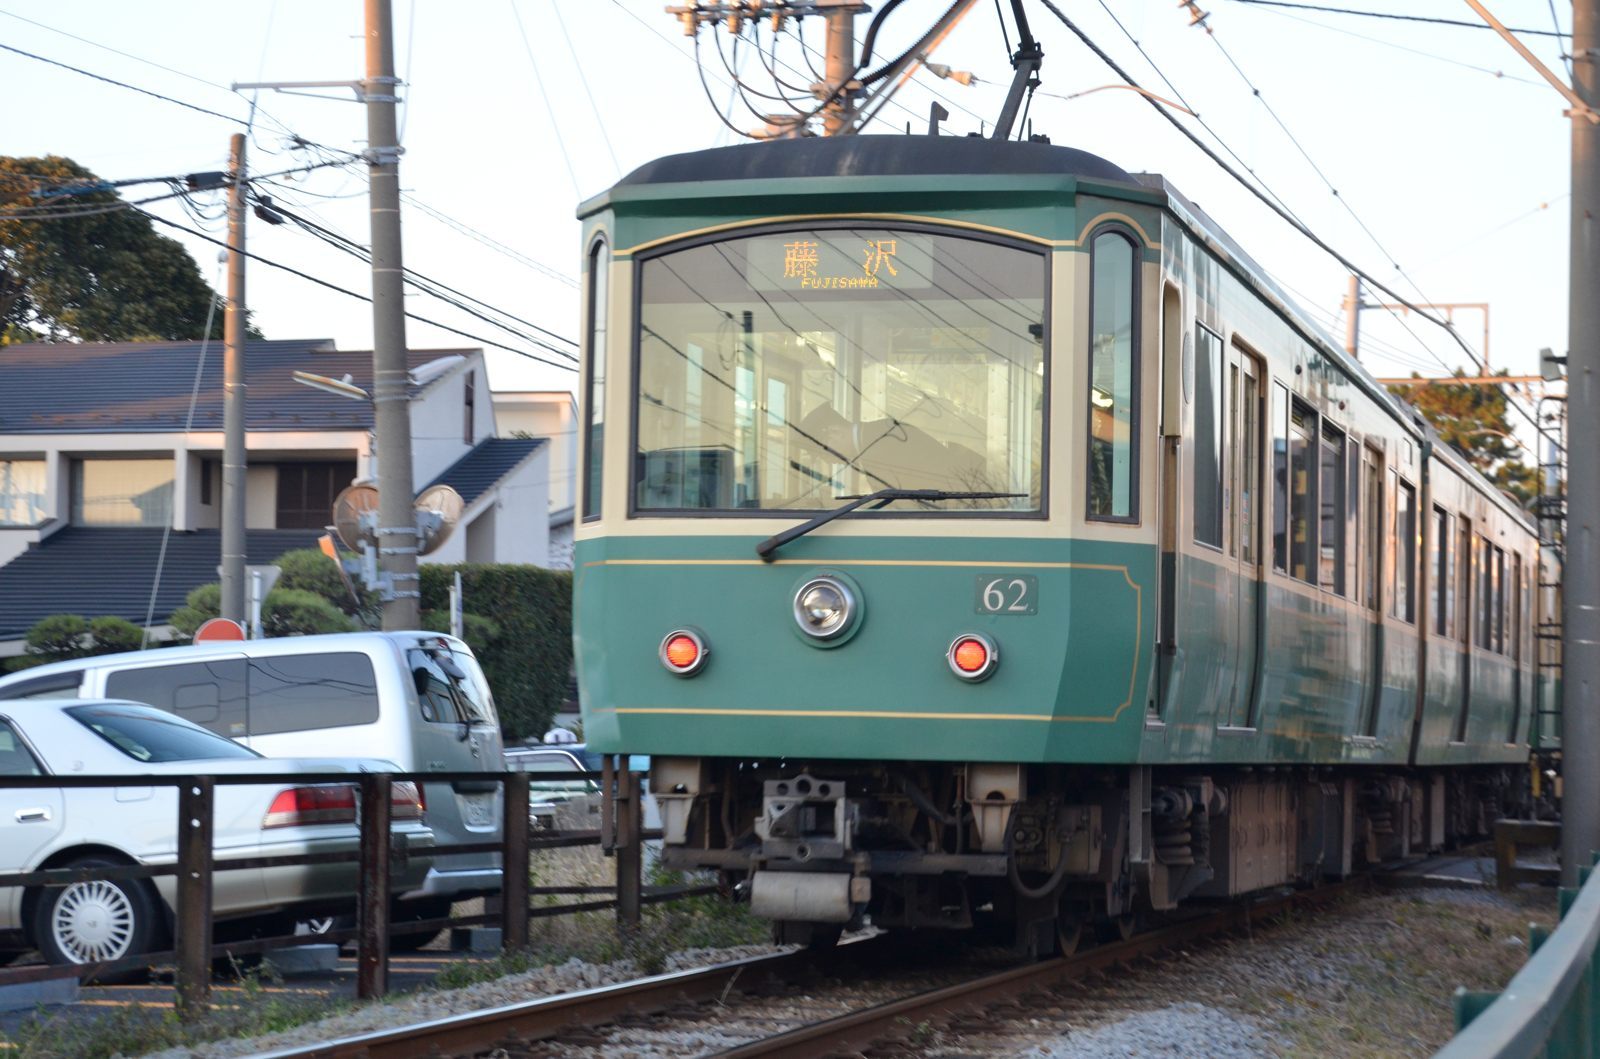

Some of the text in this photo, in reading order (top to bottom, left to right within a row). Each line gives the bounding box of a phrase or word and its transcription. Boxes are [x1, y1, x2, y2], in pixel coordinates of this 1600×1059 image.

[783, 239, 898, 277] 藤沢
[801, 277, 878, 289] FUJISAWA
[983, 578, 1029, 611] 62
